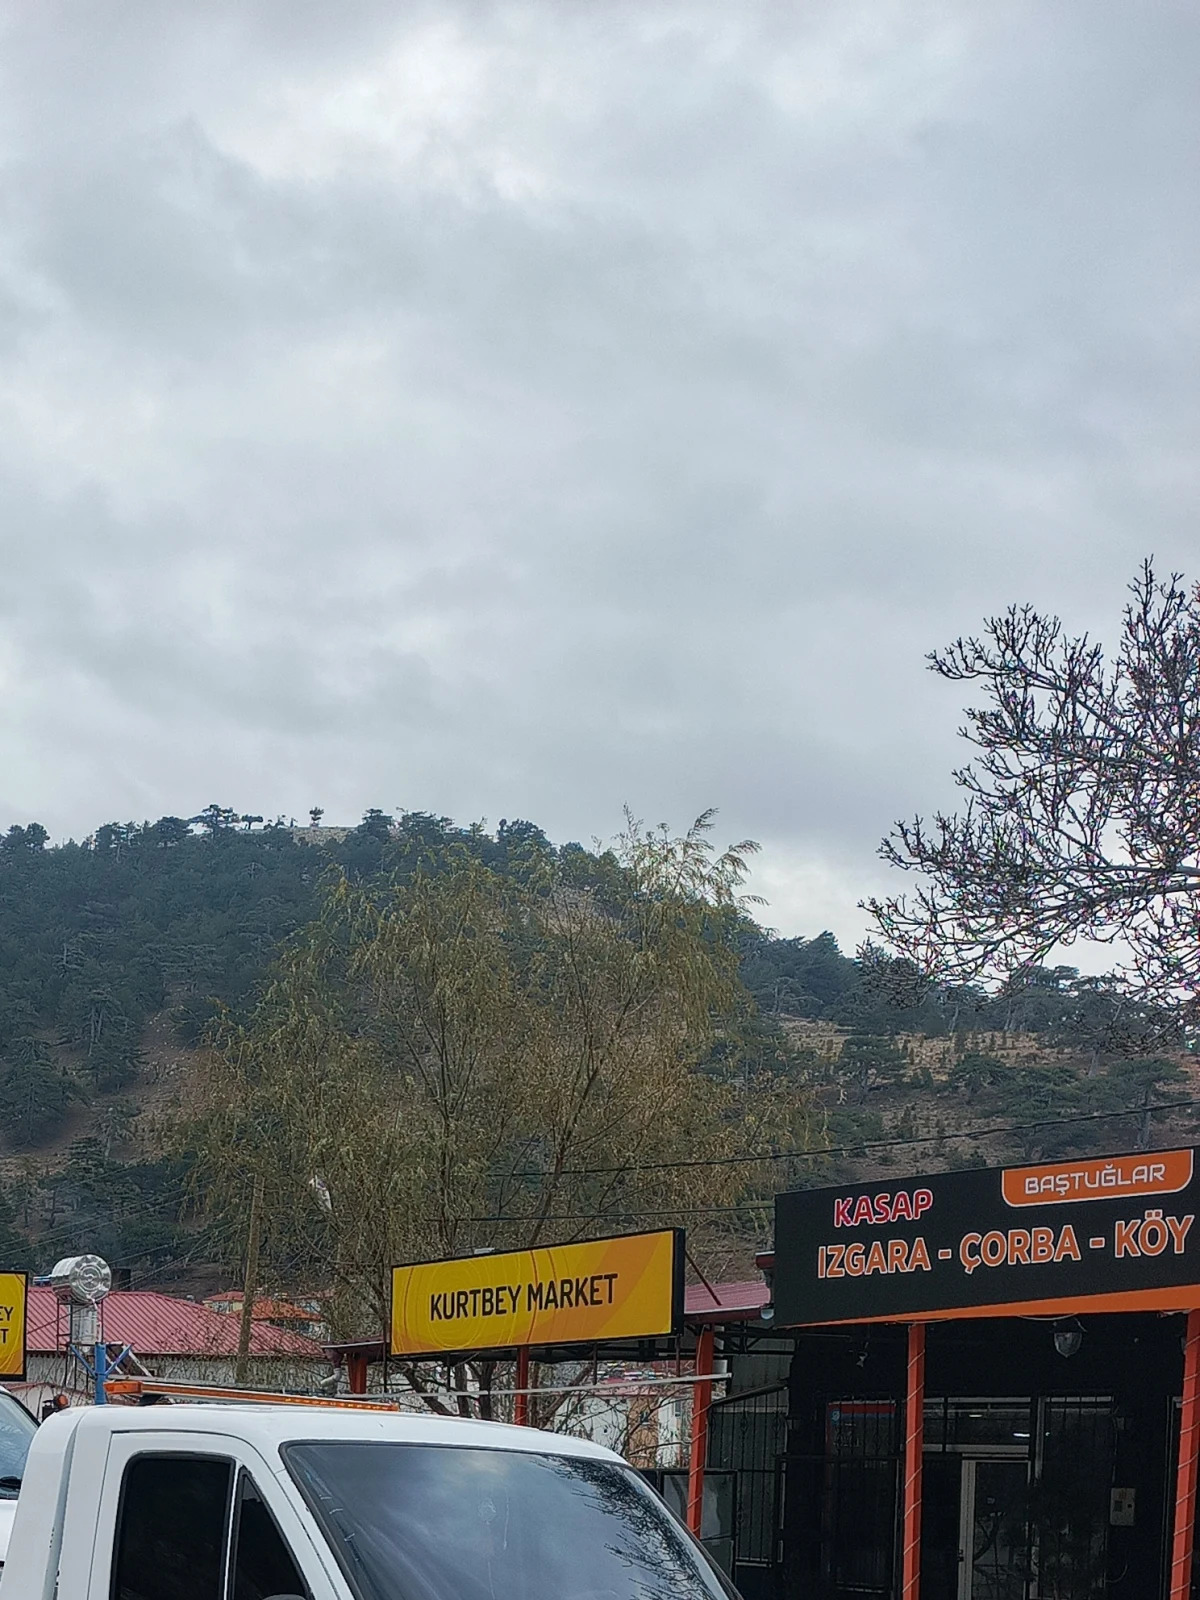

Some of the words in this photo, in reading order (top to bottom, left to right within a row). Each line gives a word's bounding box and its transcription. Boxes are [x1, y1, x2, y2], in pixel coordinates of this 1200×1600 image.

[1024, 1162, 1166, 1197] BAŞTUĞLAR
[833, 1188, 934, 1228] KASAP
[817, 1236, 932, 1279] IZGARA
[959, 1224, 1082, 1275] ÇORBA
[1113, 1209, 1195, 1259] KÖY
[429, 1282, 526, 1322] KURTBEY
[527, 1272, 615, 1311] MARKET
